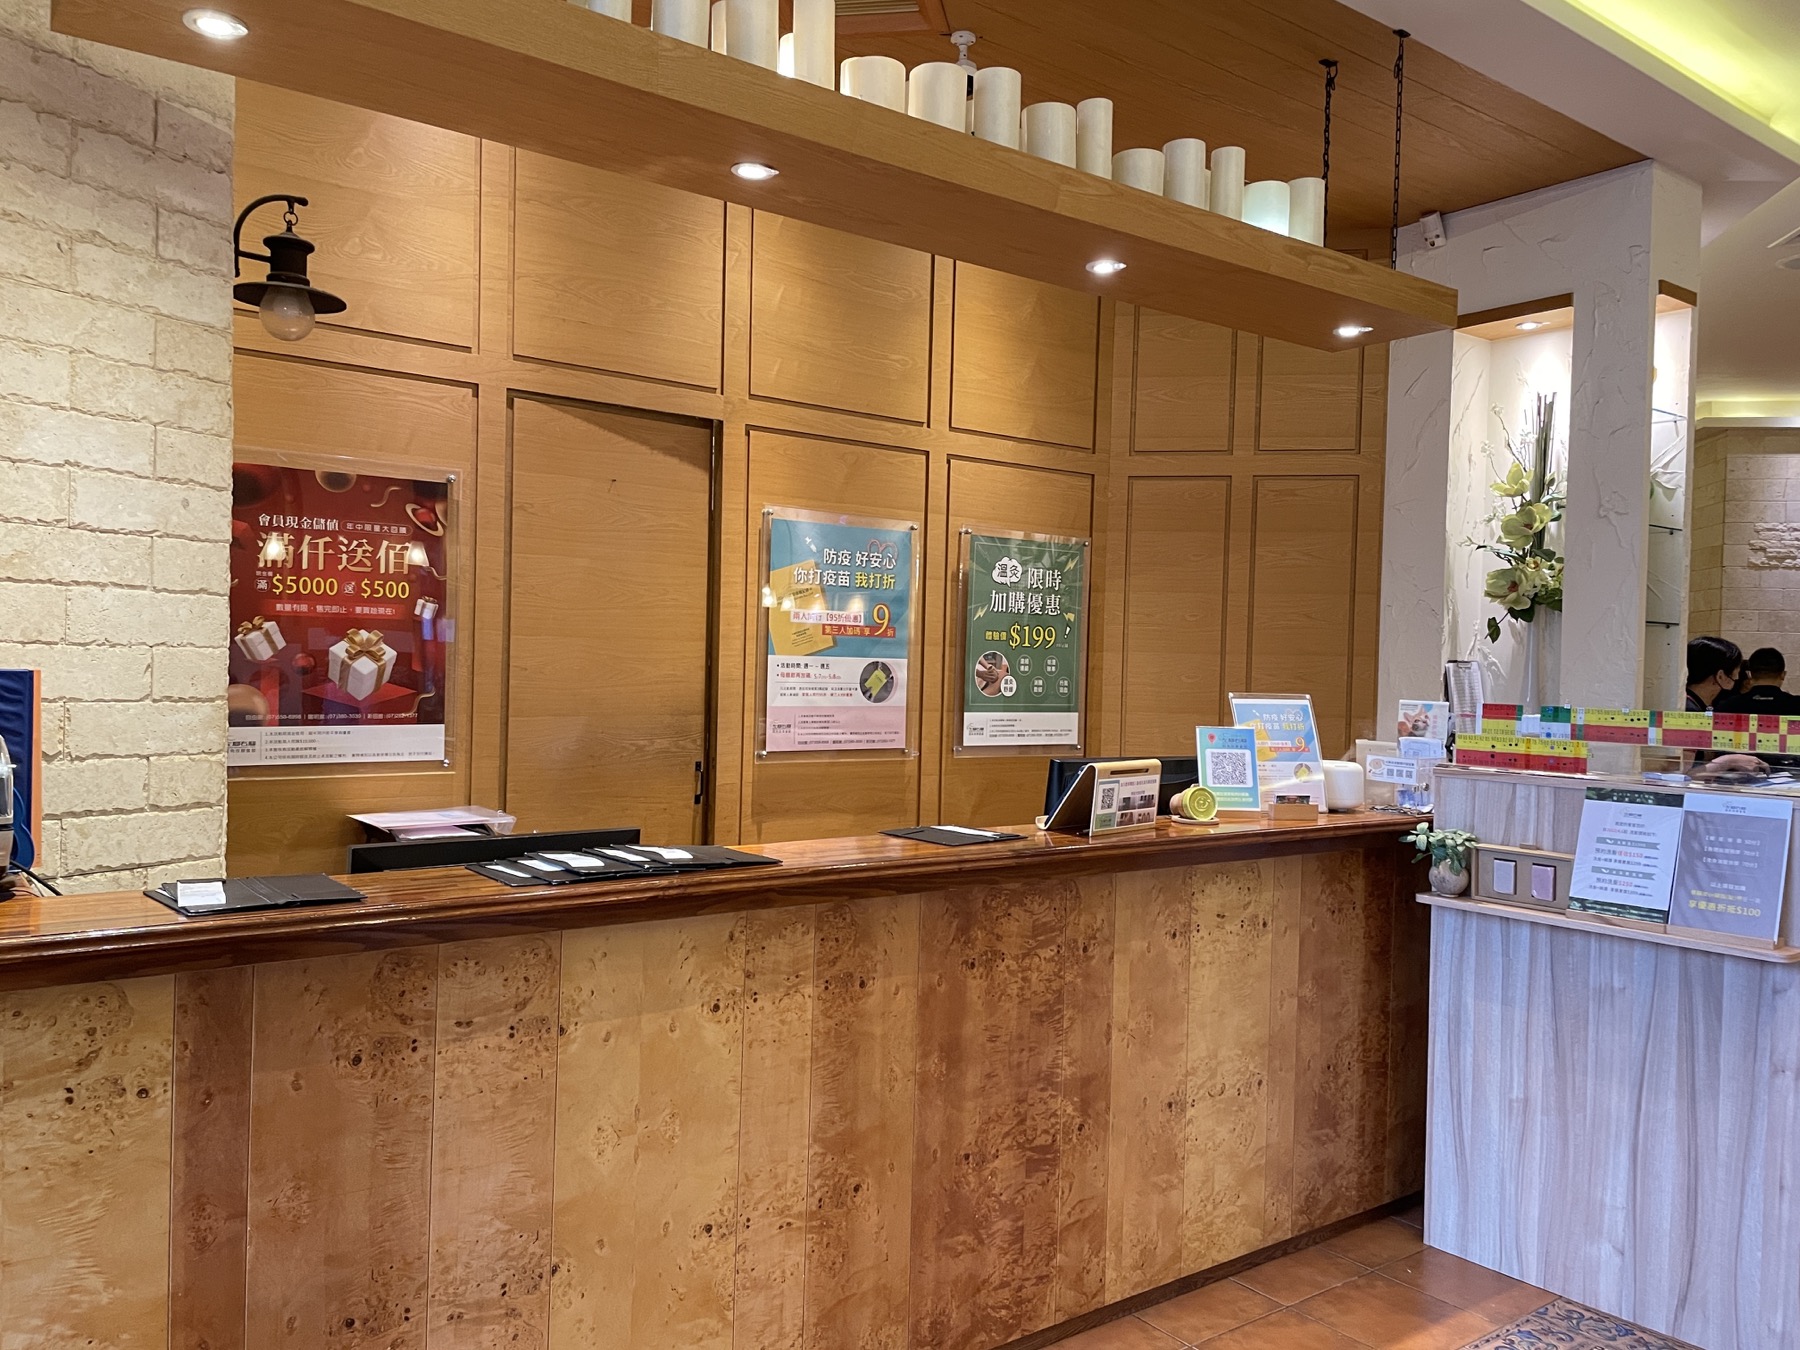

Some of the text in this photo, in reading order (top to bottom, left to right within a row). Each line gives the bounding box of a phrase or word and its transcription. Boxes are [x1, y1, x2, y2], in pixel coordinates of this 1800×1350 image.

[258, 513, 339, 531] 會員現金儲值
[256, 531, 412, 575] 滿仟送佰
[823, 548, 896, 569] 防疫 好安心
[794, 566, 896, 590] 你打疫苗 我打折
[996, 563, 1021, 579] 溫灸
[1027, 567, 1062, 591] 限時
[256, 573, 410, 599] 滿 $5000 送 $500
[989, 590, 1062, 616] 加購優惠
[873, 603, 890, 636] 9
[887, 628, 895, 637] 折
[1009, 622, 1056, 649] $199
